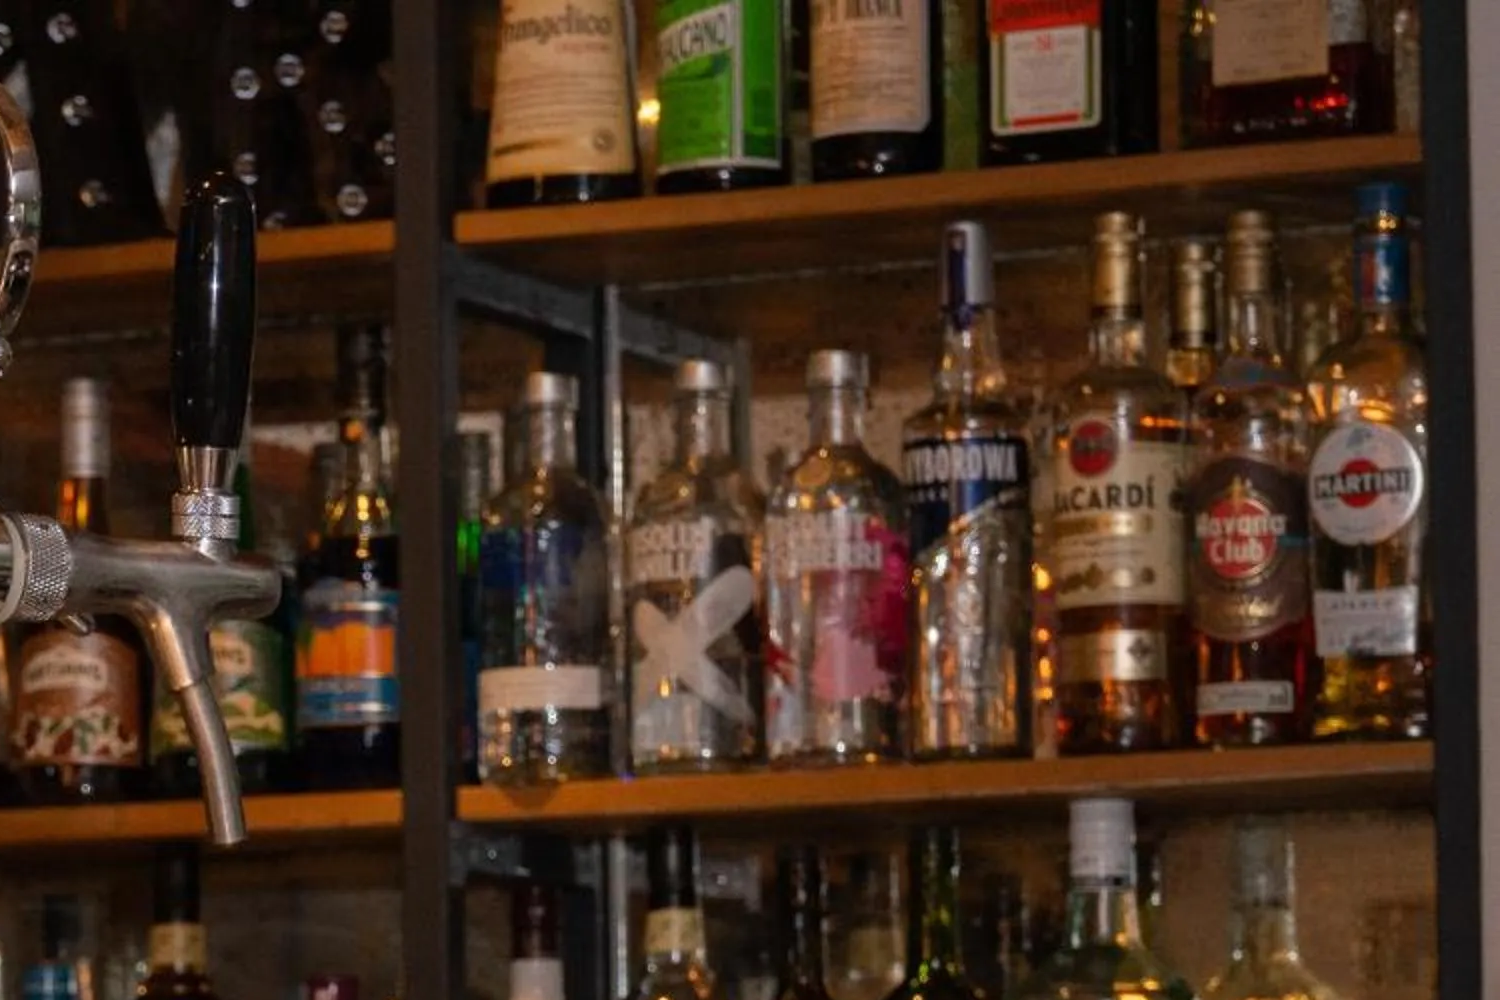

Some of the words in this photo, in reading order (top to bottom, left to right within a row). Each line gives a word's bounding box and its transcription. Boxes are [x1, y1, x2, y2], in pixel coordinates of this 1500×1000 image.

[903, 442, 1018, 485] YBOROWA
[1314, 467, 1411, 500] MARTINI
[1208, 540, 1267, 565] Club
